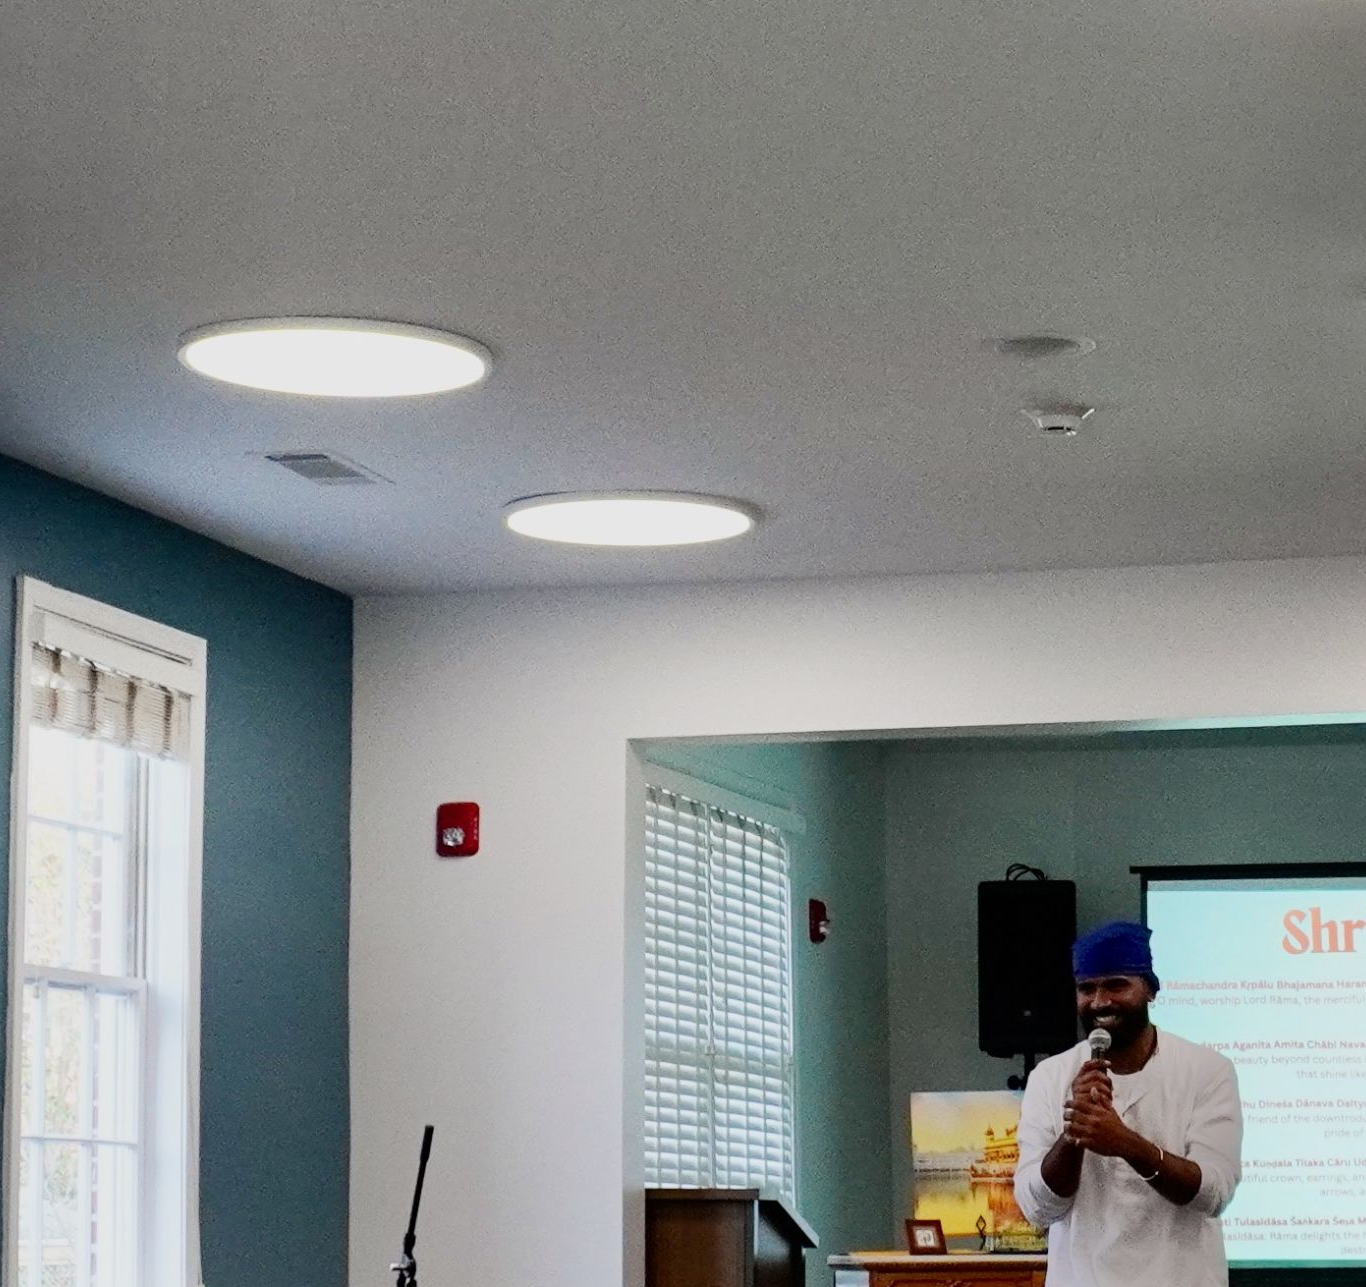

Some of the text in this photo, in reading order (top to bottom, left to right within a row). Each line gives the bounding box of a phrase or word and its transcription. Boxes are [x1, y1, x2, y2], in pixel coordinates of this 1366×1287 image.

[1201, 995, 1241, 1008] worship
[1243, 995, 1267, 1005] Lord
[1303, 994, 1321, 1004] the
[1323, 993, 1365, 1004] merciful
[1271, 1054, 1310, 1067] beyond
[1312, 1053, 1362, 1064] countless
[1296, 1069, 1318, 1079] that
[1320, 1068, 1347, 1079] shine
[1350, 1068, 1366, 1078] like
[1247, 1113, 1278, 1124] friend
[1280, 1113, 1291, 1124] of
[1293, 1113, 1311, 1124] the
[1323, 1127, 1351, 1140] pride
[1353, 1127, 1364, 1138] of
[1300, 1230, 1341, 1243] delights
[1343, 1229, 1360, 1240] the
